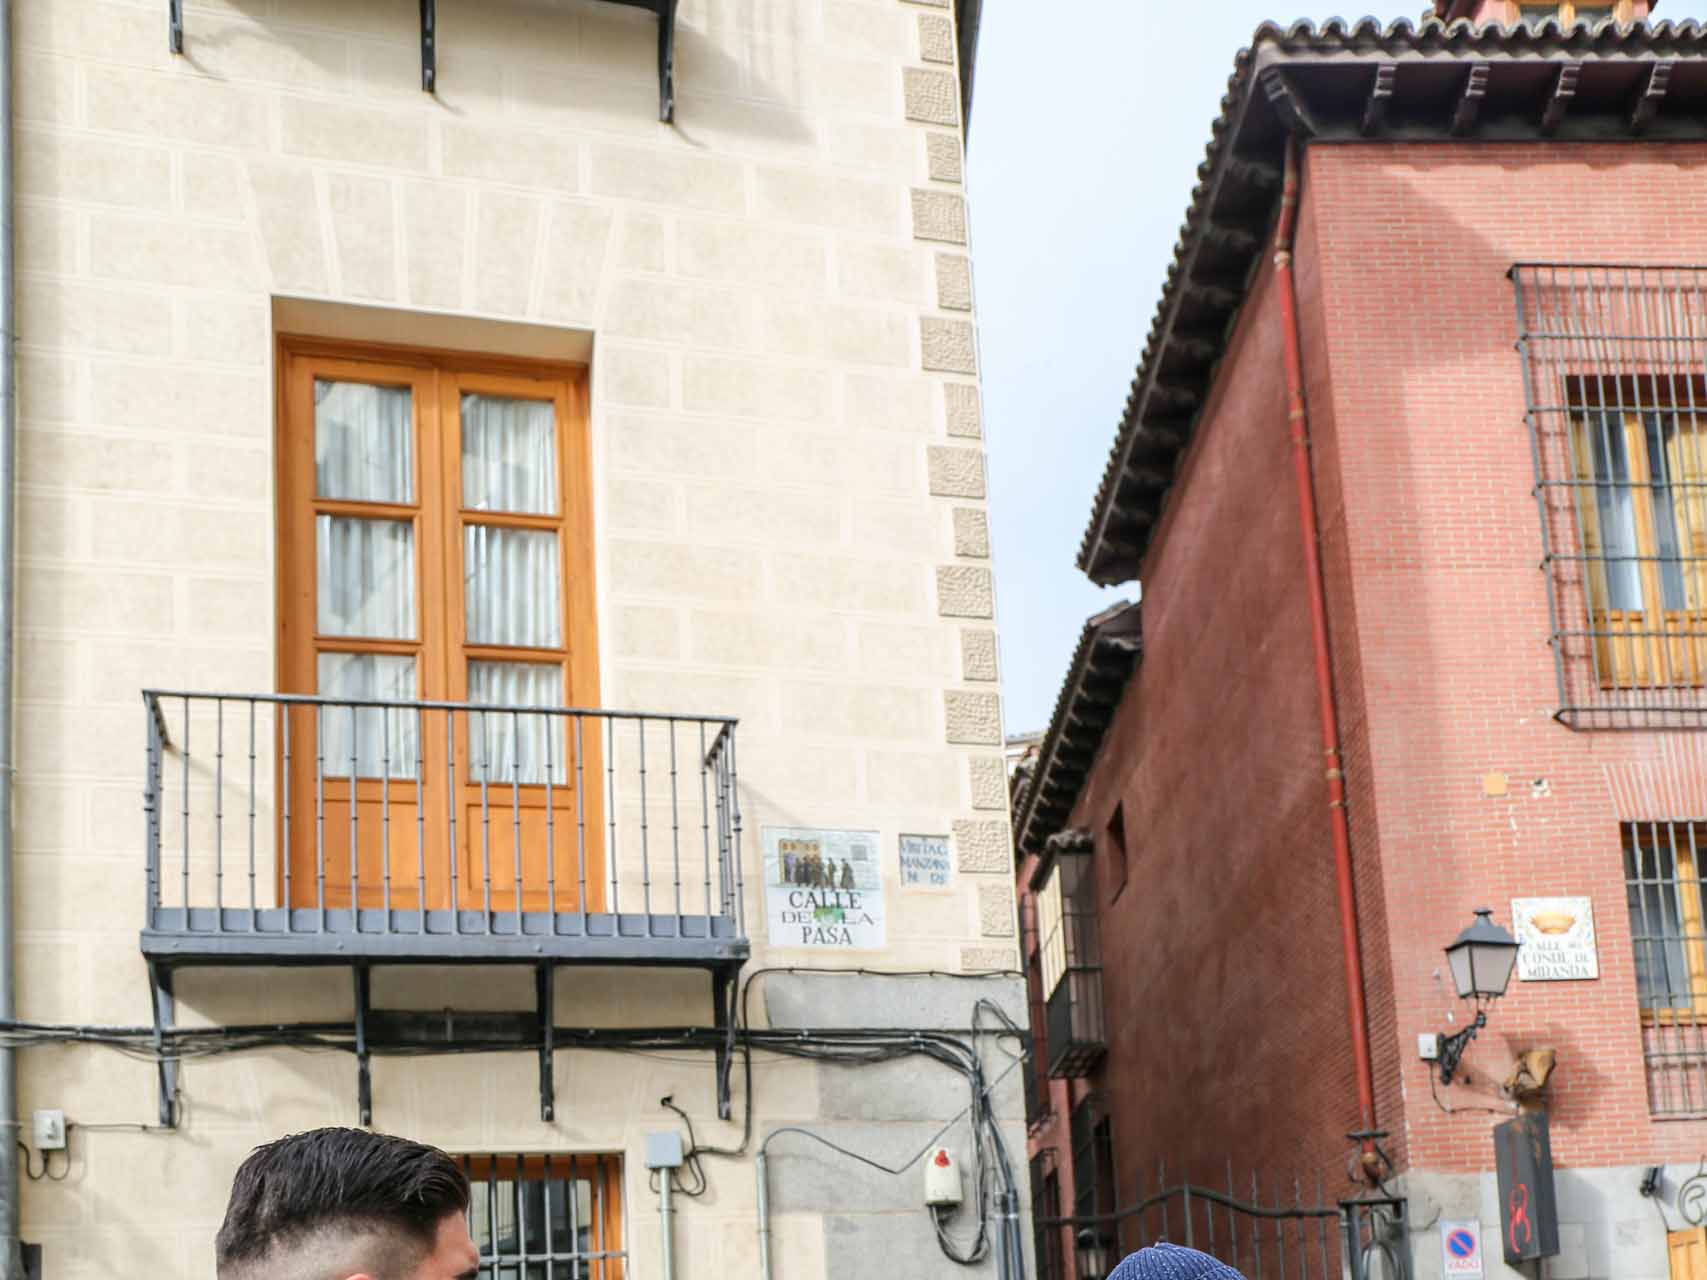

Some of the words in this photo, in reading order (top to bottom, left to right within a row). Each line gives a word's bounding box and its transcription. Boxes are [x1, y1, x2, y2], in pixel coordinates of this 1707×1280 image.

[788, 890, 863, 909] CALLE
[781, 911, 813, 924] DE
[840, 912, 875, 925] LA
[801, 926, 853, 945] PASA
[1522, 952, 1569, 963] CONDE
[1528, 965, 1589, 976] MIRANDA
